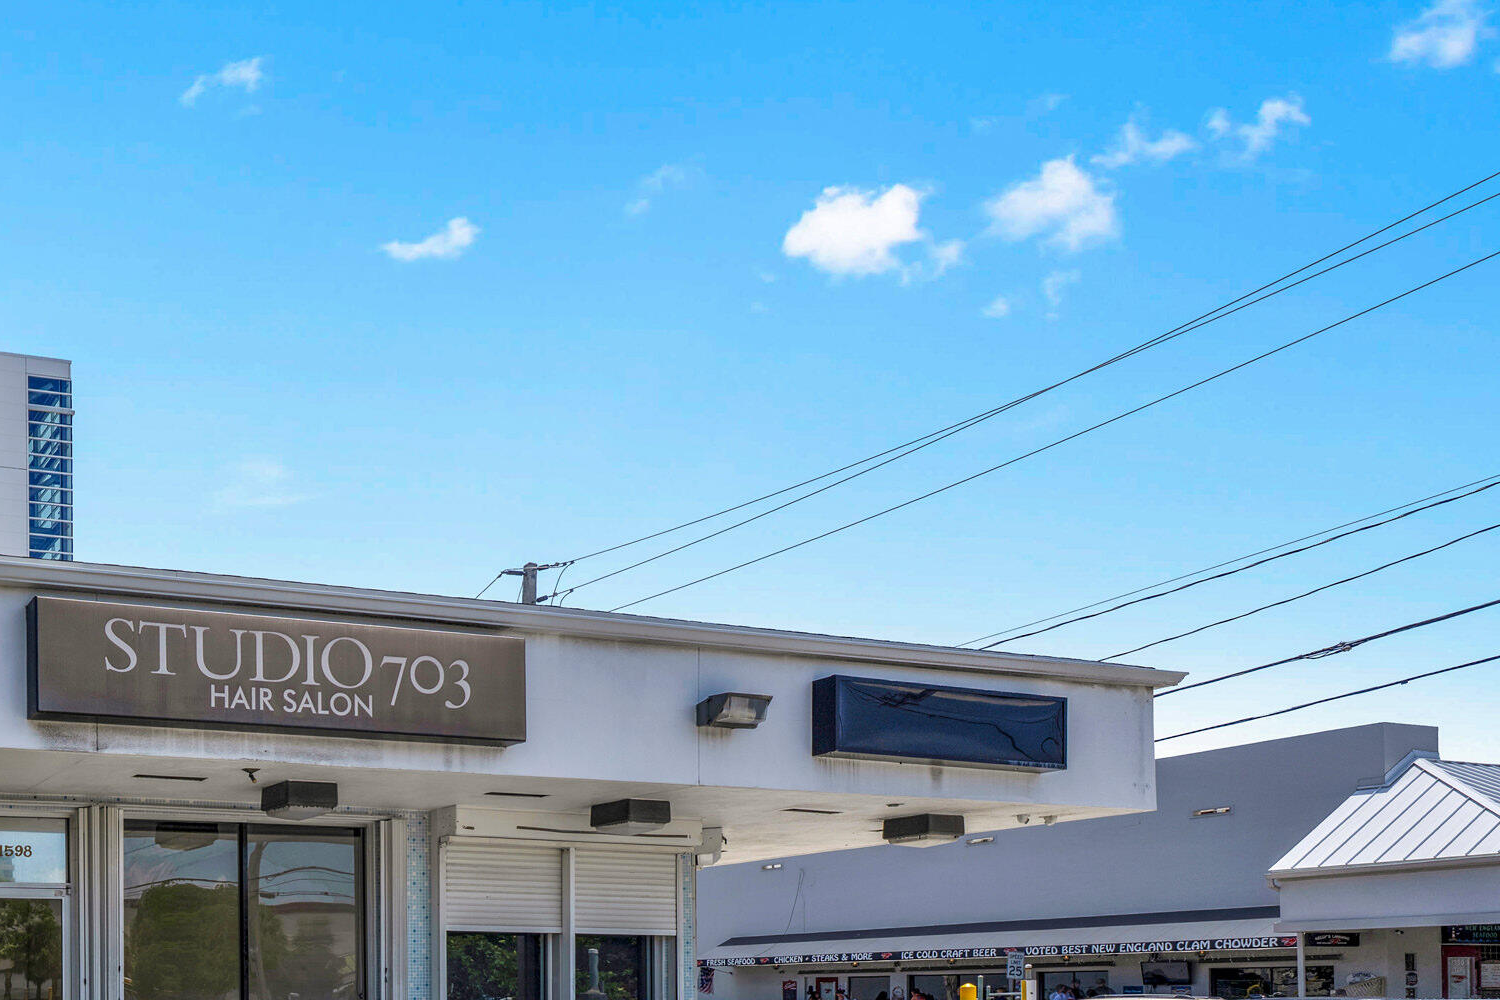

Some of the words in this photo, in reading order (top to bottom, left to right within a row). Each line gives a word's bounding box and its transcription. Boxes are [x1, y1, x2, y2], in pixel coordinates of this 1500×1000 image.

[104, 618, 373, 689] STUDIO
[379, 655, 472, 710] 703
[210, 684, 275, 712] HAIR
[283, 688, 373, 718] SALON
[706, 958, 726, 966] FRESH
[727, 957, 756, 966] SEAFOOD
[773, 955, 803, 963] CHICKEN
[811, 954, 839, 962] STEAKS
[841, 953, 849, 961] &
[851, 952, 873, 960] MORE
[901, 951, 914, 959] ICE
[916, 950, 939, 959] COLD
[941, 949, 970, 958] CRAFT
[972, 948, 997, 957] BEER
[1025, 946, 1056, 955] VOTED
[1061, 944, 1089, 954] BEST
[1091, 944, 1116, 953] NEW
[1119, 942, 1173, 952] ENGLAND
[1176, 940, 1211, 950] CLAM
[1215, 938, 1278, 948] CHOWDER
[1009, 966, 1022, 976] 25
